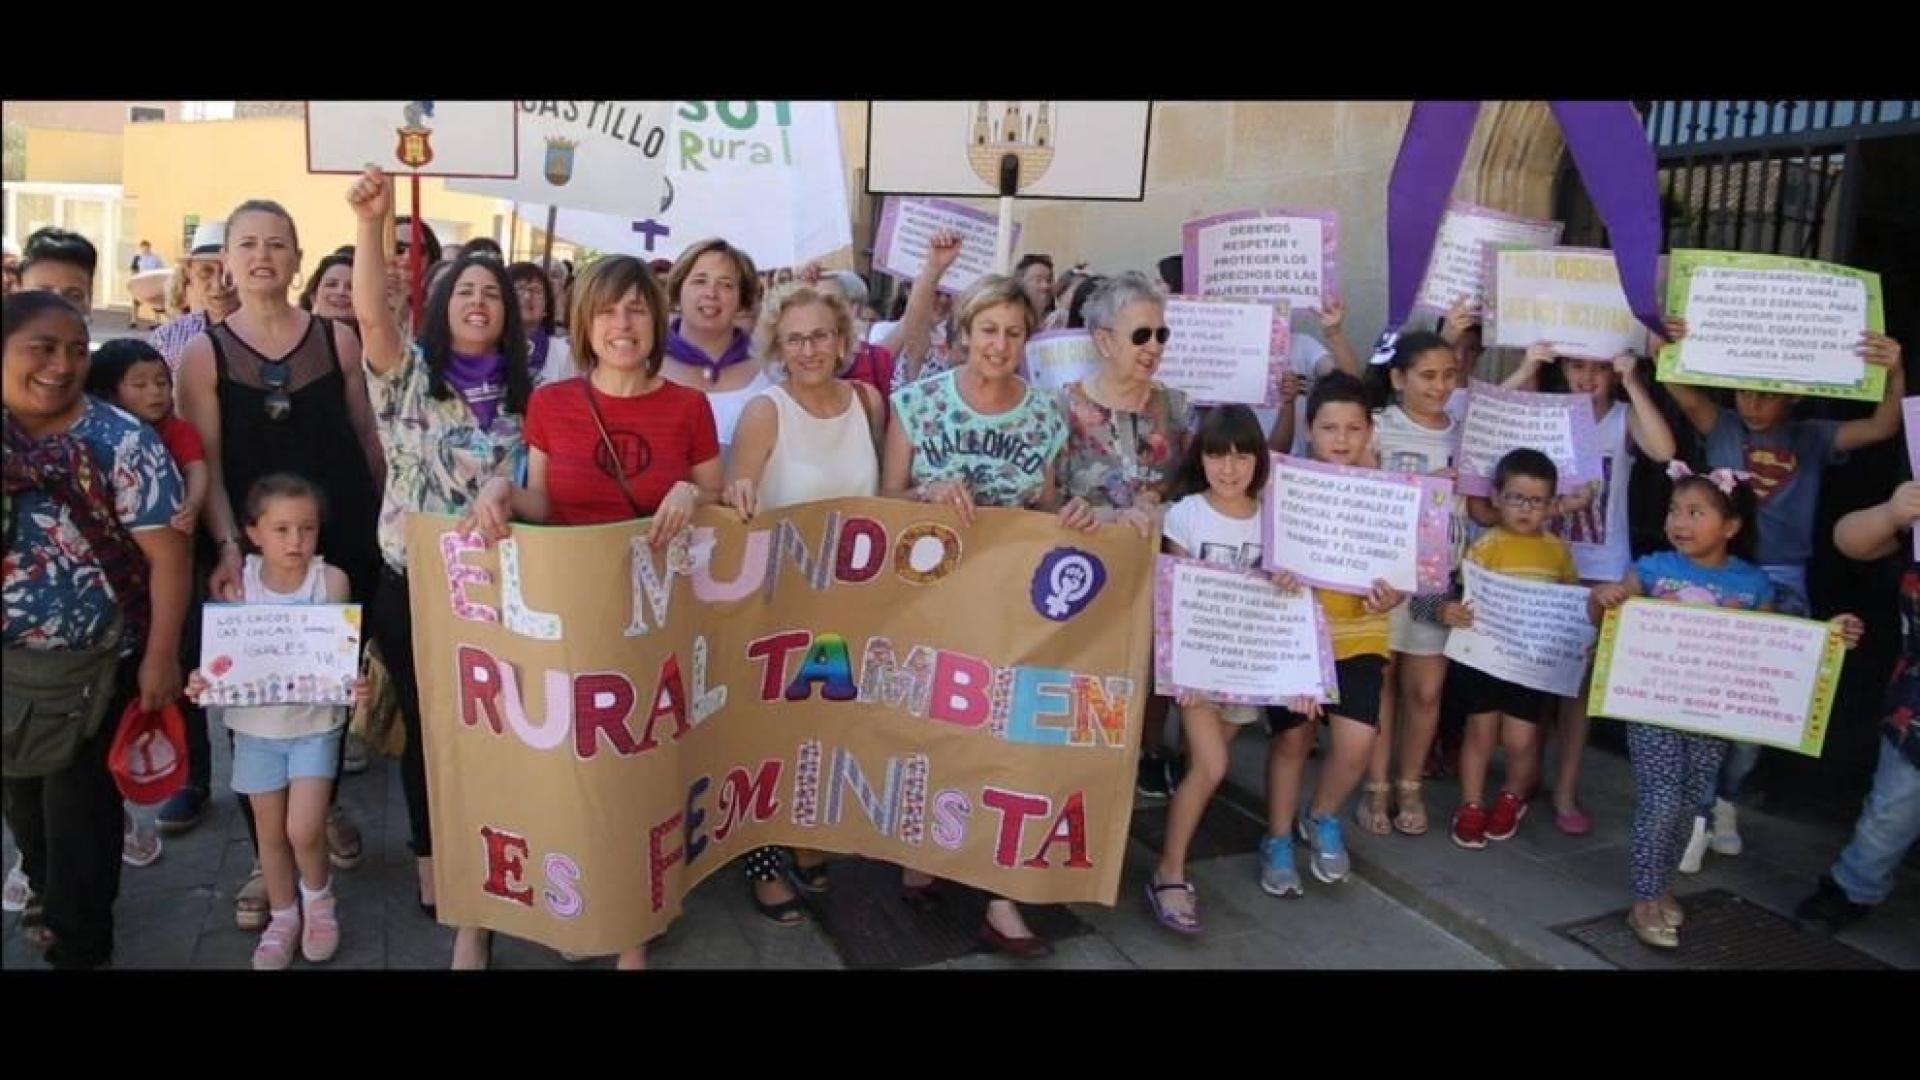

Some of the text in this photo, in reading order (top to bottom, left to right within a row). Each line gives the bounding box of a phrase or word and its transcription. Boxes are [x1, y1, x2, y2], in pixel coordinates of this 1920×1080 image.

[680, 130, 792, 172] Rural
[1229, 223, 1290, 236] DEBEMOS
[1223, 239, 1288, 251] RESPETAR
[1213, 253, 1308, 266] PROTEGER LOS
[1205, 269, 1273, 283] DERECHOS
[1295, 269, 1318, 280] LAS
[1280, 471, 1416, 502] MEJORAR LA VIDA DE LAS
[1287, 488, 1405, 514] MUJERES RURALES ES
[1280, 500, 1408, 530] ESENCIAL PARA LUCHAR
[1280, 512, 1320, 531] CONTRA
[1323, 524, 1339, 535] LA
[1342, 542, 1355, 554] EL
[1358, 545, 1400, 561] CAMBIO
[440, 511, 962, 641] EL MUNDO
[1279, 613, 1307, 623] PARA
[1669, 612, 1731, 627] PUEDO
[1735, 619, 1791, 635] DECIR
[1639, 623, 1806, 653] LAS MUJERES SON
[1667, 653, 1702, 667] LOS
[456, 629, 1135, 760] RURAL TAMBIEN
[1612, 685, 1649, 700] QUE
[1655, 693, 1679, 704] NO
[1683, 697, 1720, 710] SON
[1725, 688, 1780, 706] DECIR
